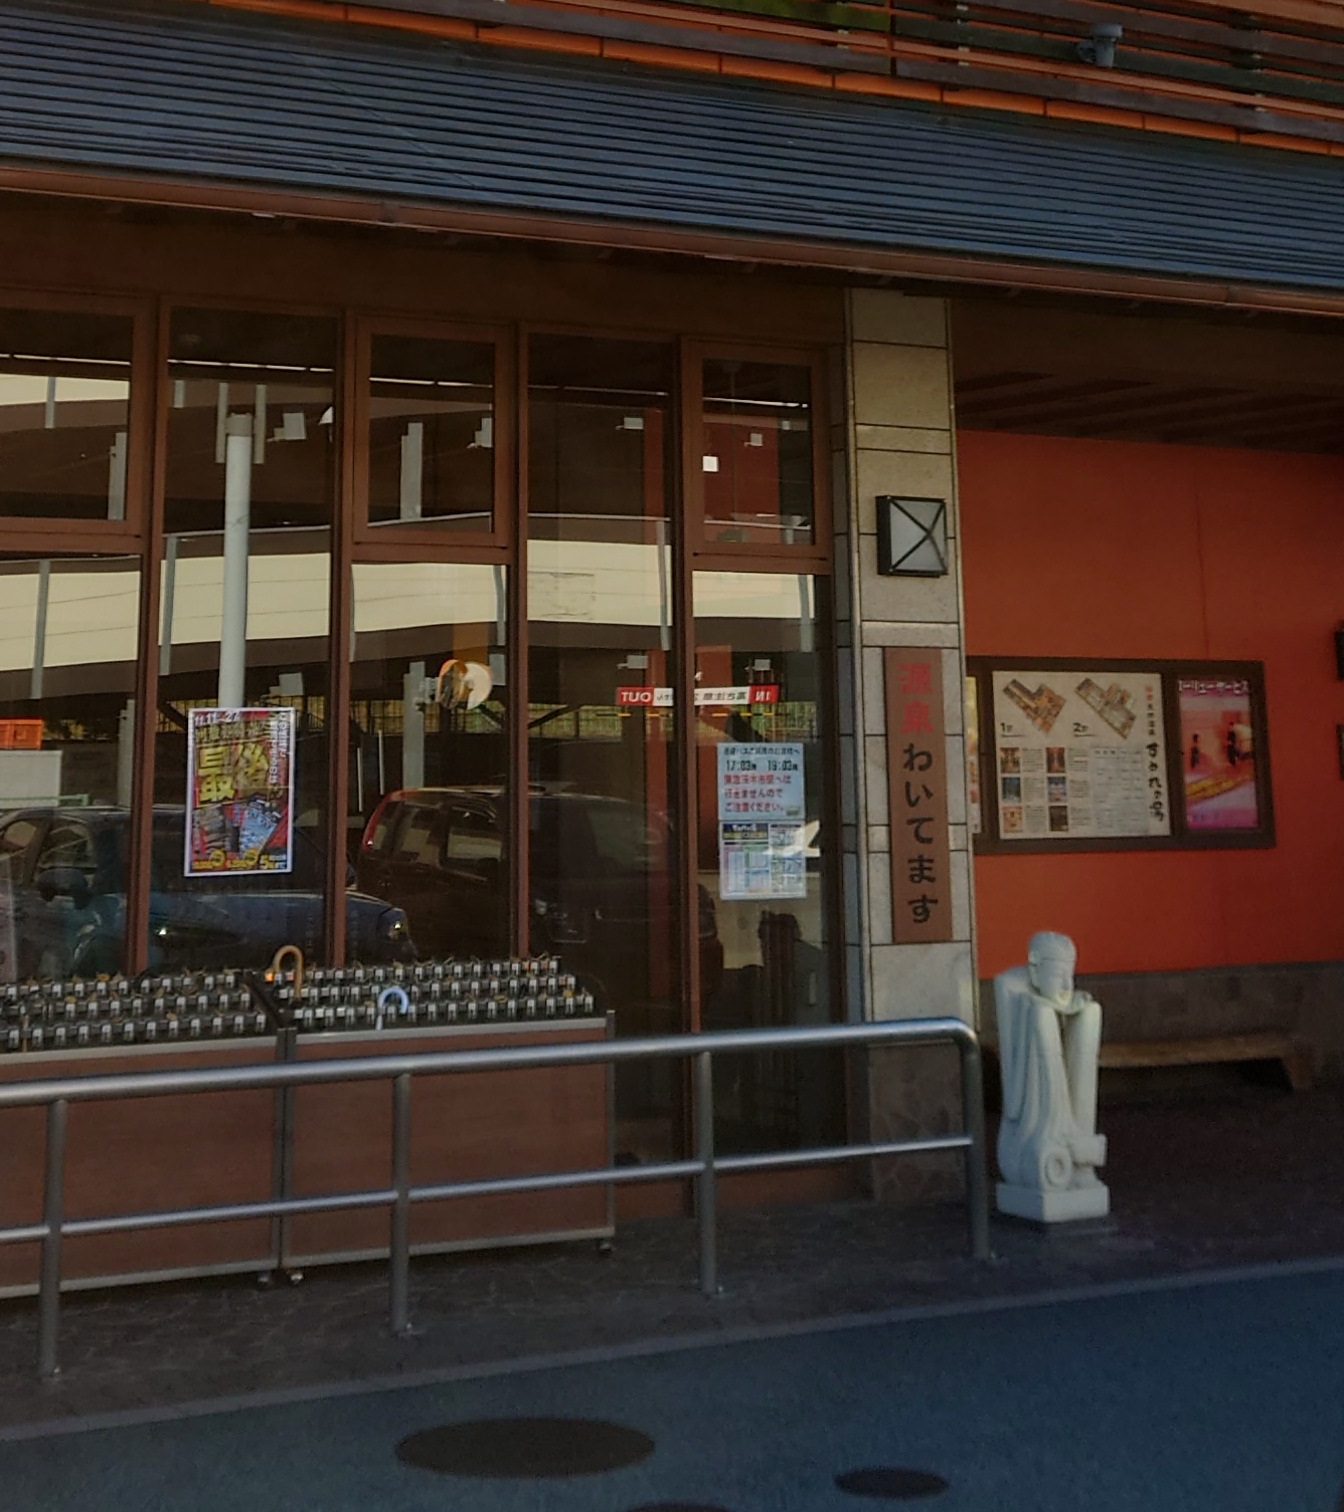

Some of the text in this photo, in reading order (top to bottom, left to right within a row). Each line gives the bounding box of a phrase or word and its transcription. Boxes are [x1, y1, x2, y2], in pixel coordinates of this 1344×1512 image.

[898, 663, 938, 923] 源泉わいてます
